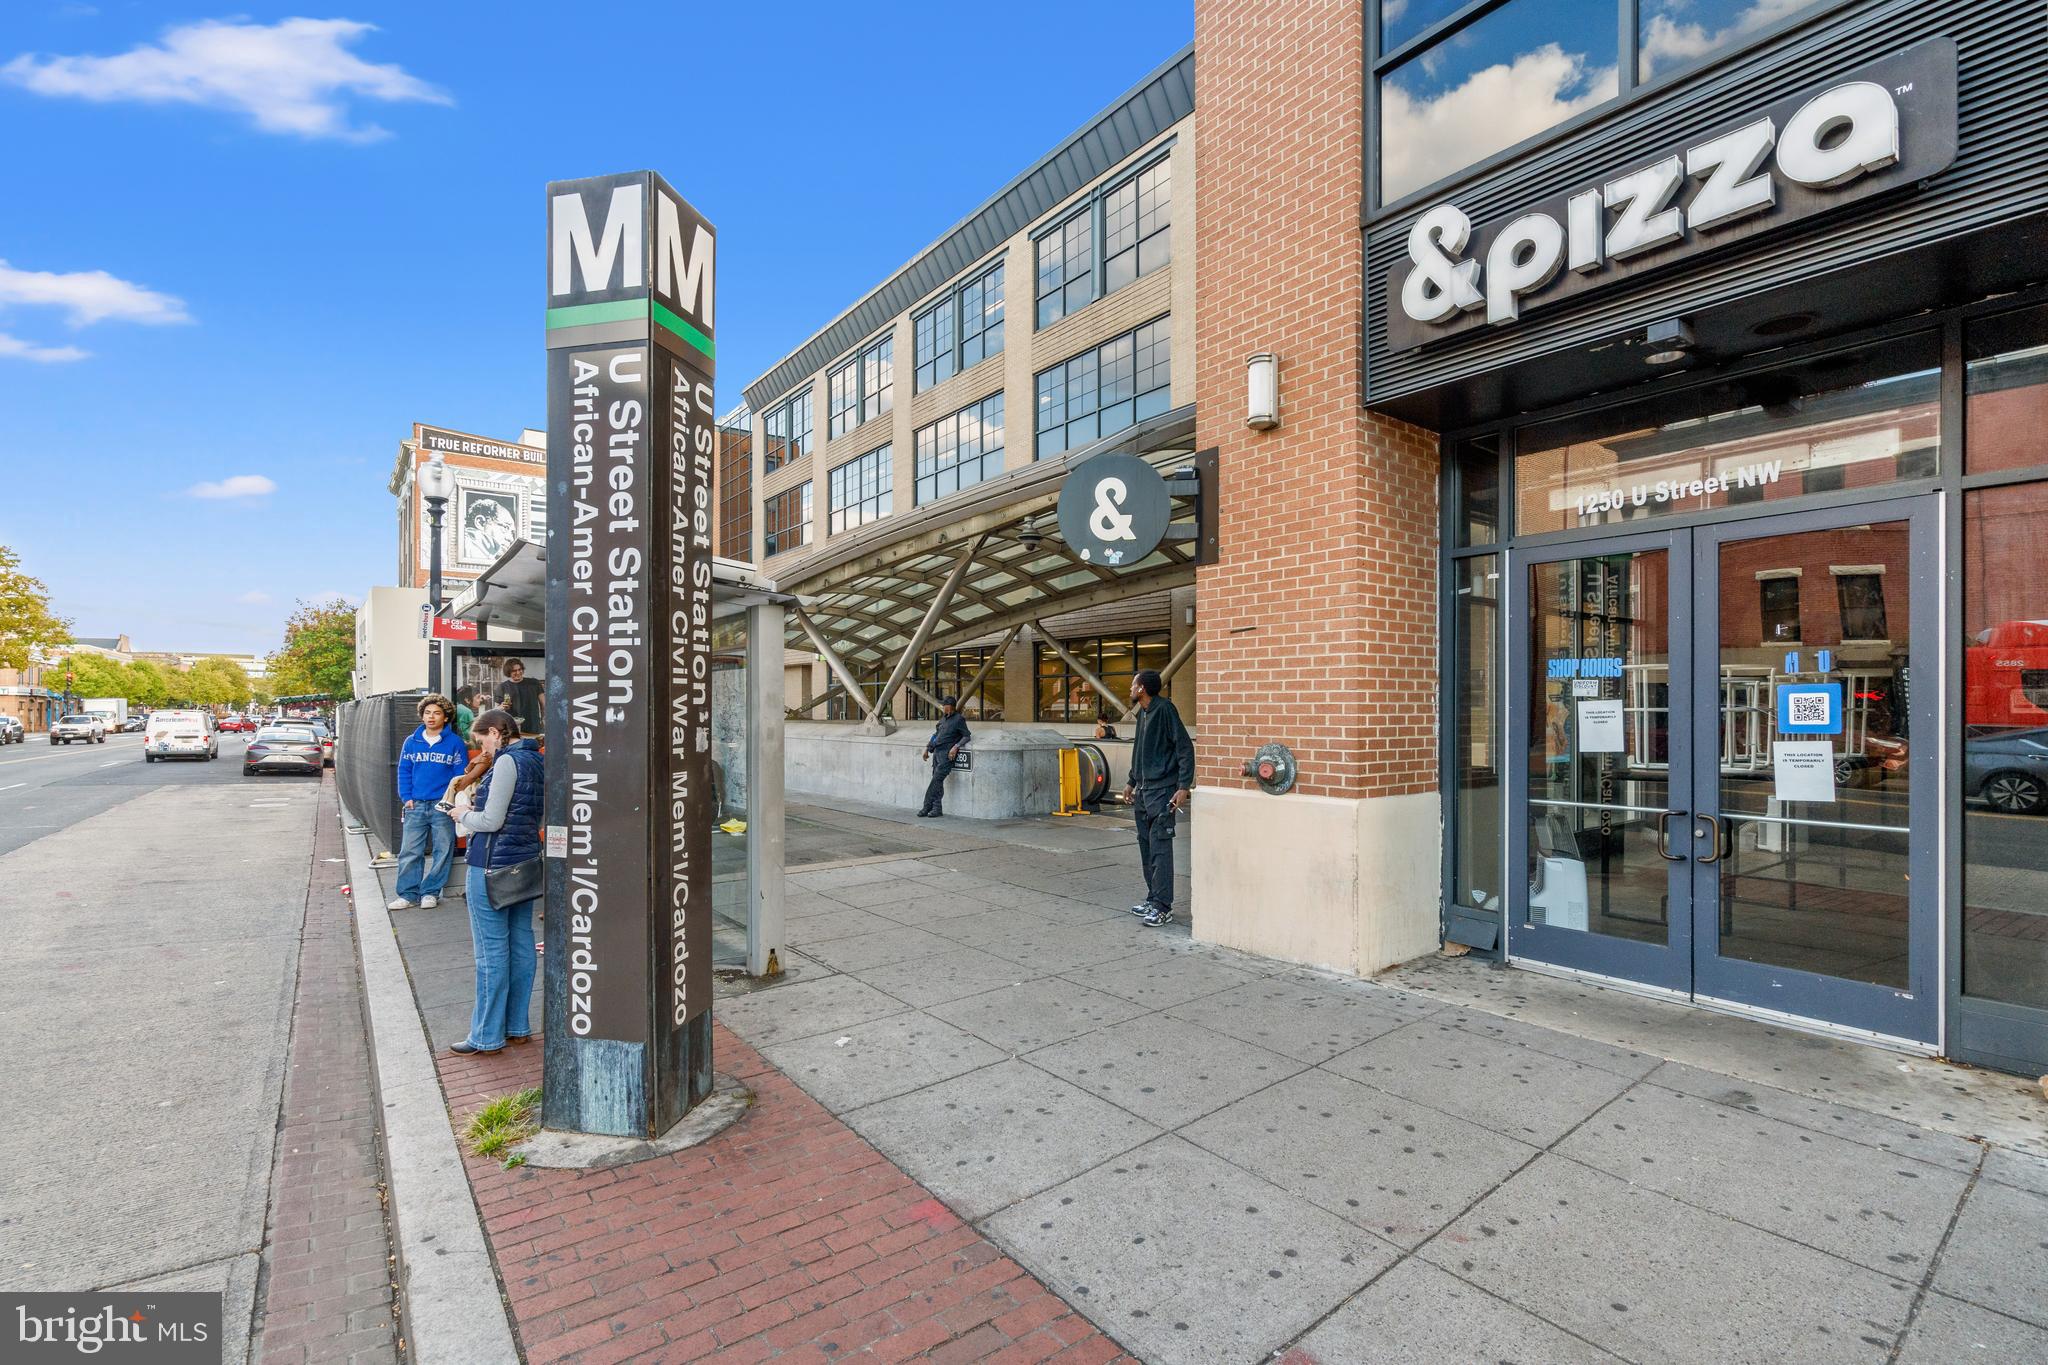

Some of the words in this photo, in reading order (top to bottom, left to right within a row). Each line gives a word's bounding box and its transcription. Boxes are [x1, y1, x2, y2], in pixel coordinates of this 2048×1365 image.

[552, 183, 642, 296] M
[657, 188, 714, 330] M
[608, 353, 642, 383] U
[695, 382, 713, 416] U
[429, 436, 460, 451] TRUE
[462, 441, 520, 460] REFORMER
[573, 359, 600, 595] African-Amer
[608, 400, 642, 533] Street
[672, 366, 690, 600] African-Amer
[693, 425, 713, 549] Street
[1576, 489, 1625, 516] 1250
[1631, 484, 1647, 506] U
[1654, 470, 1730, 502] Street
[1737, 459, 1783, 489] NW
[1089, 477, 1137, 541] &
[572, 606, 599, 682] Civil
[608, 547, 642, 704] Station
[672, 610, 688, 684] Civil
[693, 560, 711, 705] Station
[1547, 658, 1579, 678] SHOP
[1580, 657, 1623, 678] HOURS
[572, 692, 598, 761] War
[672, 693, 688, 760] War
[571, 773, 599, 1035] Mem'l/Cardozo
[672, 771, 689, 1026] Mem'l/Cardozo
